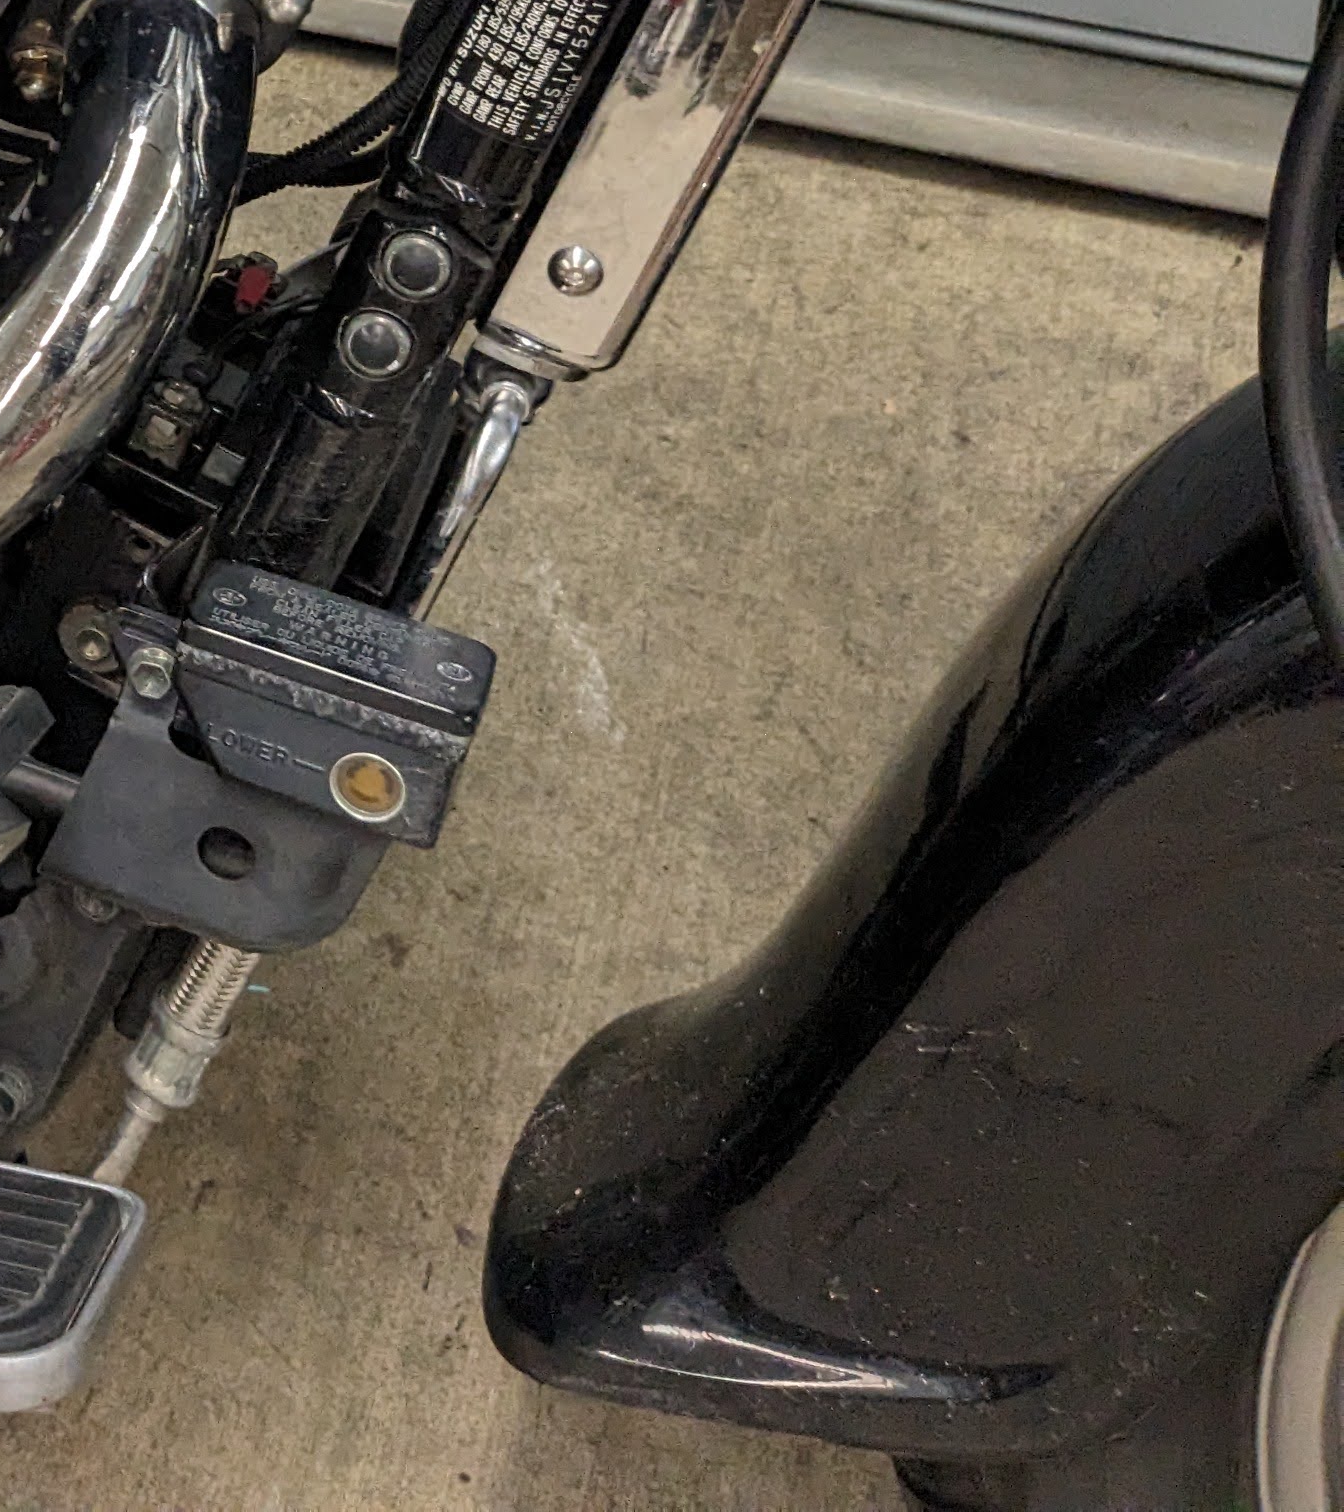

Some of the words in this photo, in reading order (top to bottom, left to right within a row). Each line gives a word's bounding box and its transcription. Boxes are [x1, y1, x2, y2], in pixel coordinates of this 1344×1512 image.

[456, 4, 491, 59] SUZUKI
[446, 81, 466, 106] GVWR
[472, 34, 492, 58] 1180
[458, 89, 480, 115] GAWR
[471, 60, 495, 91] FRONT
[487, 42, 506, 62] 430
[472, 98, 495, 123] GAWR
[484, 74, 507, 100] REAR
[500, 50, 521, 69] 750
[486, 104, 511, 129] THIS
[501, 61, 534, 103] VEHICLE
[525, 13, 560, 61] CONFORMS
[502, 99, 531, 136] SAFETY
[522, 47, 560, 99] STANDARDS
[286, 619, 392, 662] WARNING
[206, 722, 290, 764] LOWER
